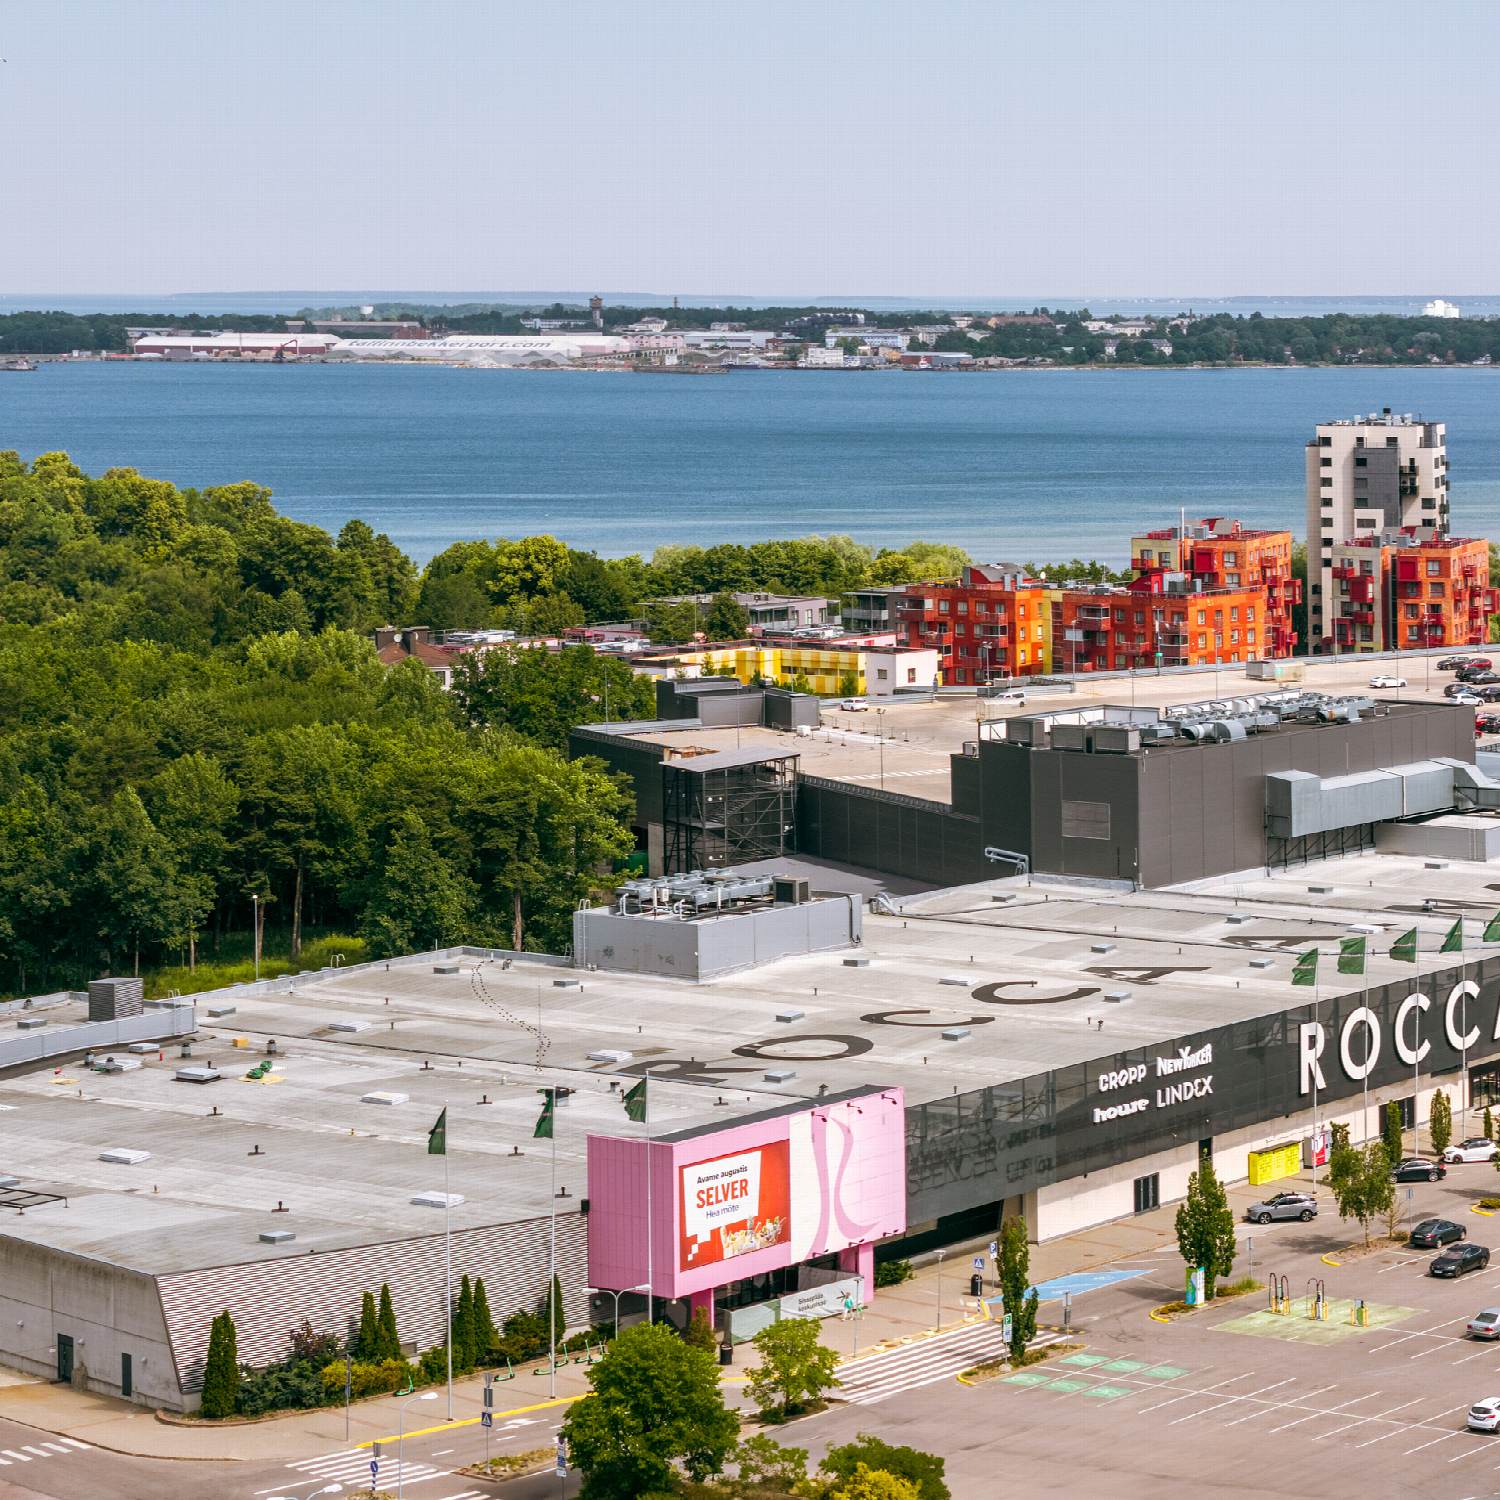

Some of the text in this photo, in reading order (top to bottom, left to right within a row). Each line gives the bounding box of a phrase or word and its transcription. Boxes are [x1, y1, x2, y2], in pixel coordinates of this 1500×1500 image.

[1098, 1063, 1147, 1092] CROPP
[1156, 1075, 1213, 1108] LINDEX
[697, 1164, 749, 1185] Avame augustis
[696, 1178, 749, 1209] SELVER
[705, 1203, 740, 1220] Hea mõte
